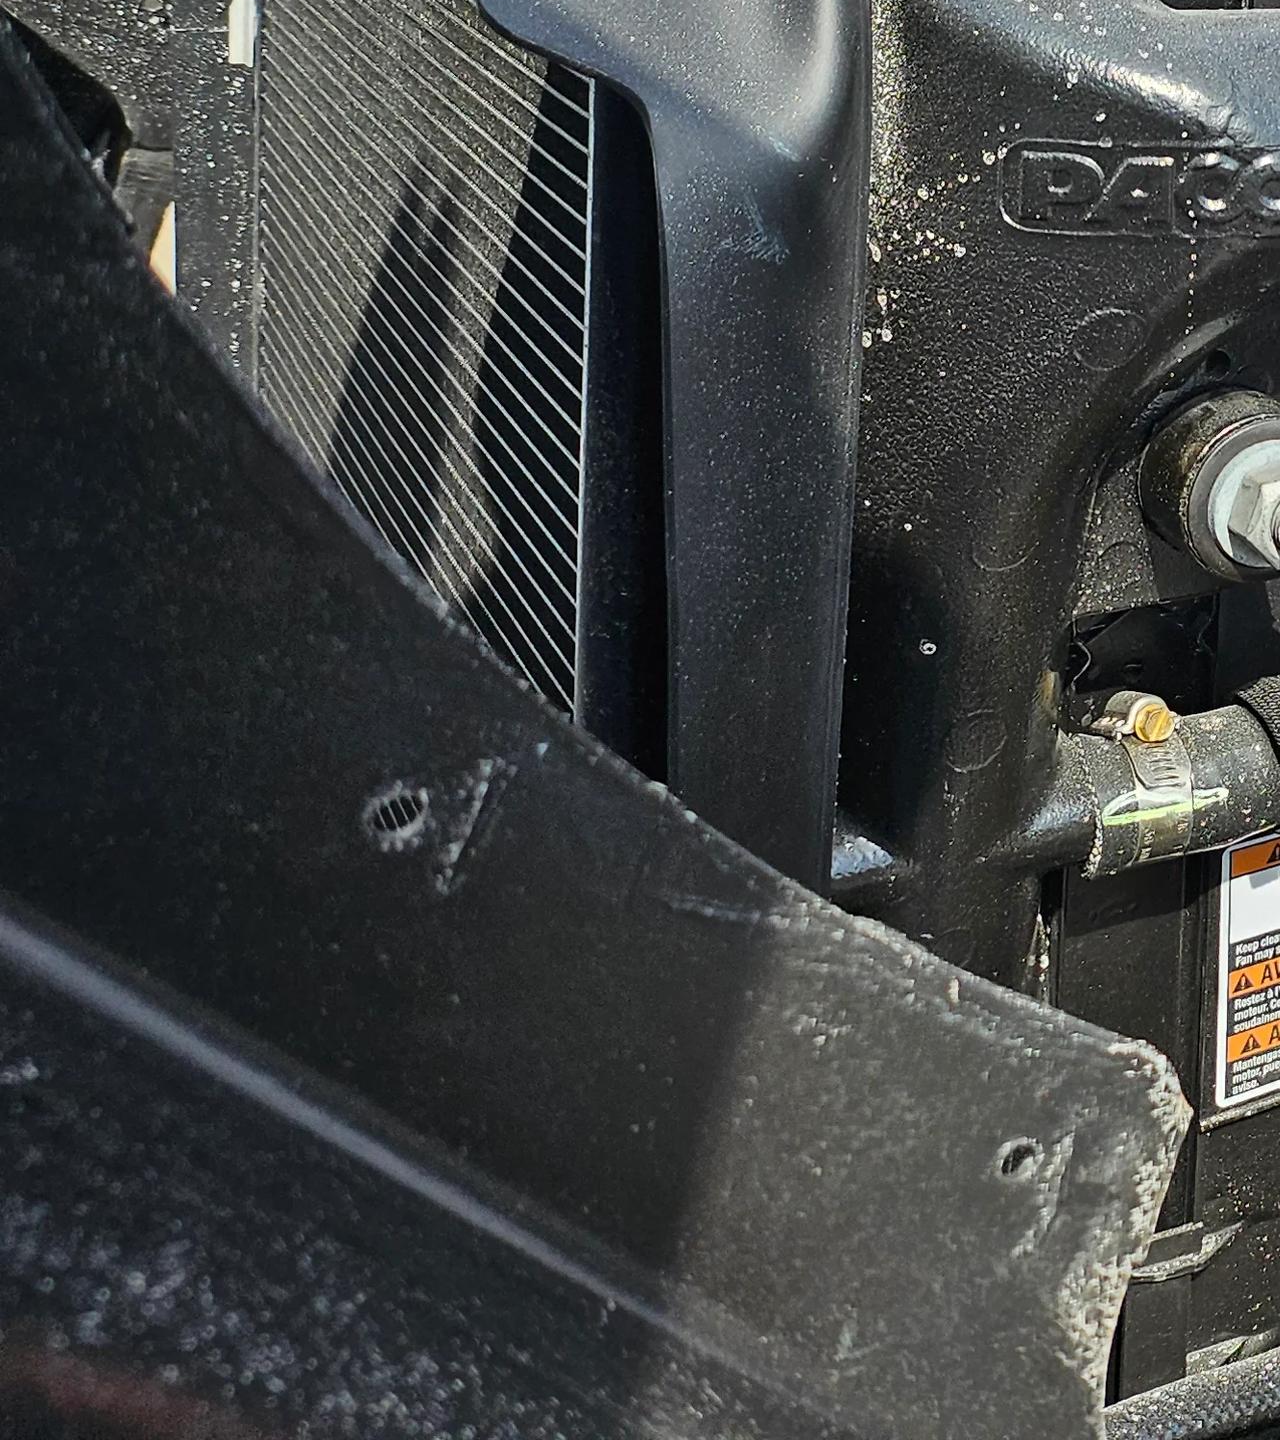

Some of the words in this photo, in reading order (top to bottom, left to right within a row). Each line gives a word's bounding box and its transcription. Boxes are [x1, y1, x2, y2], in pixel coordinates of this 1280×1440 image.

[1236, 941, 1259, 956] Keep
[1236, 954, 1252, 968] Fan
[1254, 946, 1274, 962] may
[1234, 993, 1265, 1010] Restez
[1234, 1004, 1269, 1022] moteur.
[1232, 1078, 1260, 1095] aviso.
